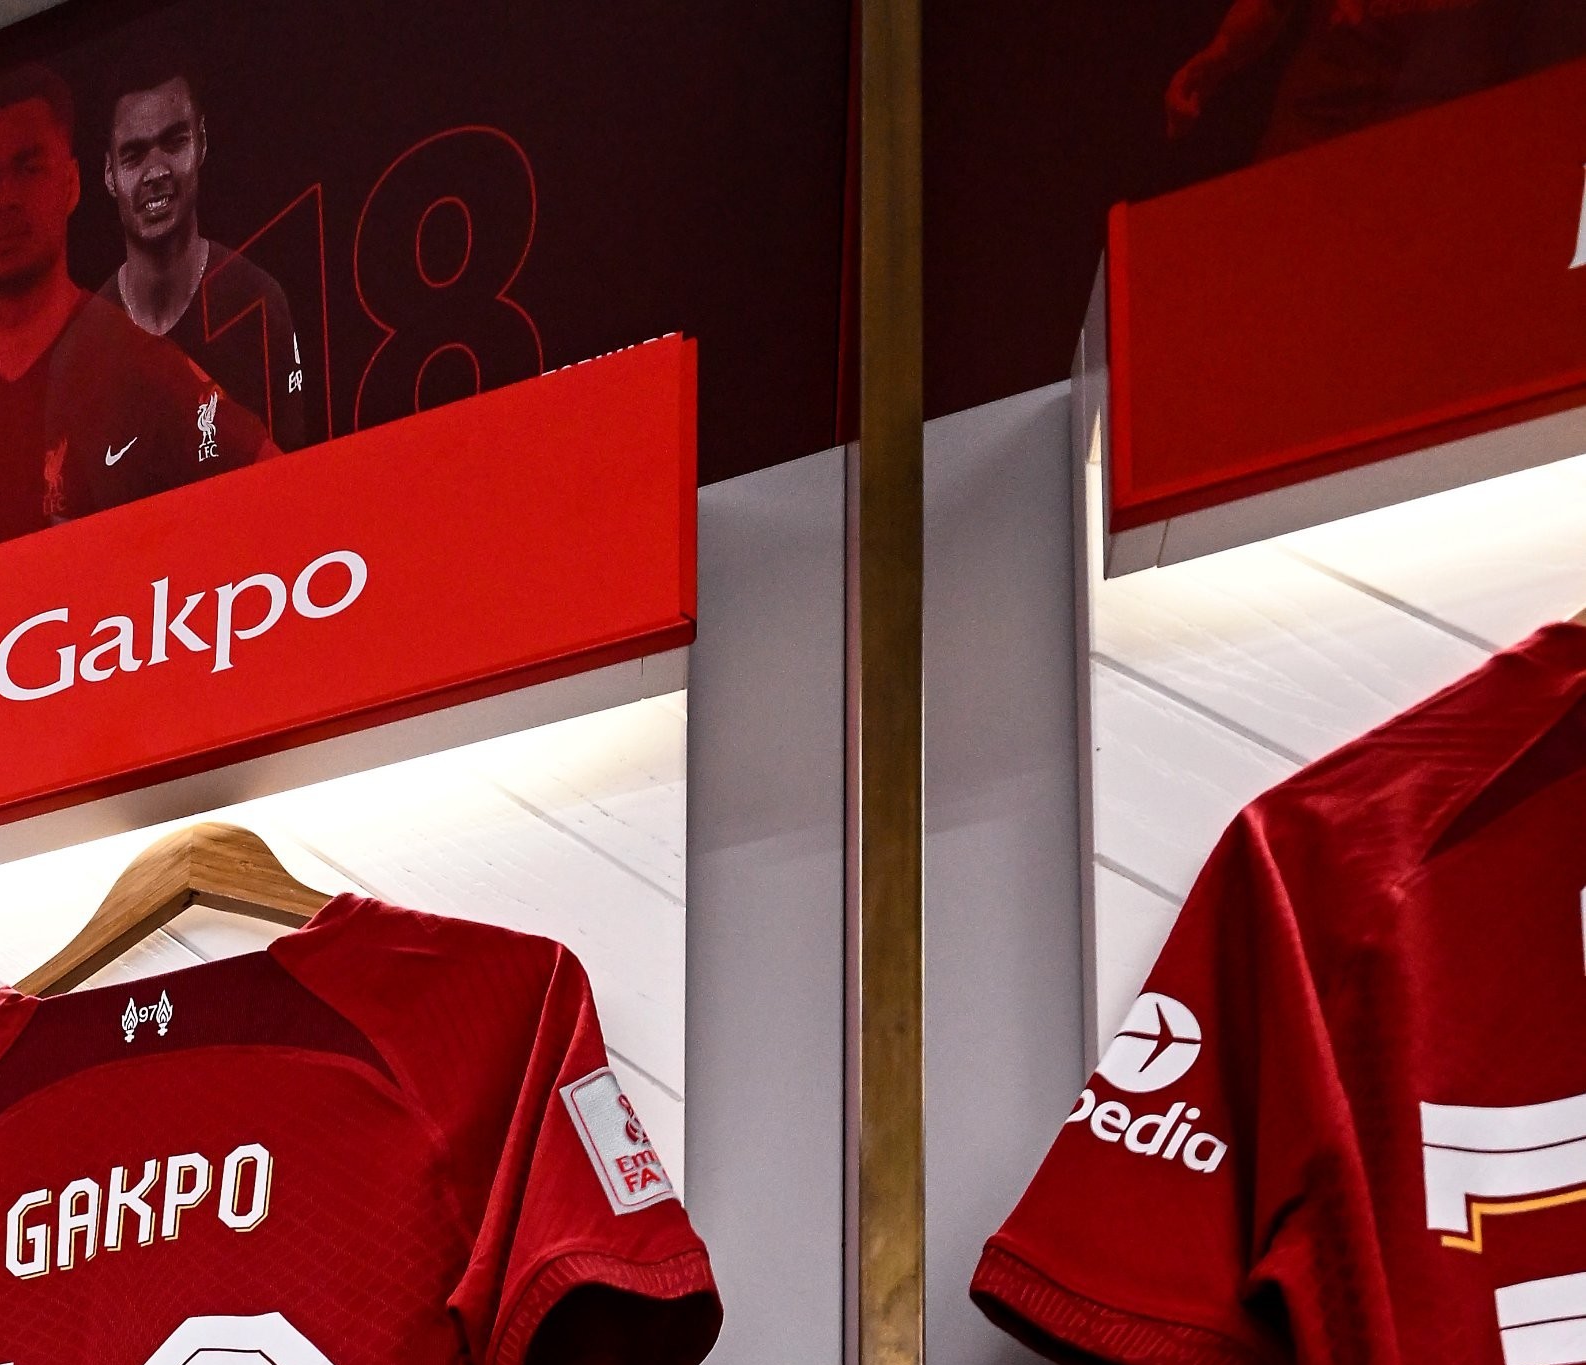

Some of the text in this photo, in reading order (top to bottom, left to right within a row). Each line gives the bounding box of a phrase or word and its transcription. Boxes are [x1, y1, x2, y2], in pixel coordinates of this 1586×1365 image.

[138, 1004, 158, 1023] 97
[624, 1167, 661, 1194] FA
[5, 1142, 274, 1280] GAKPO
